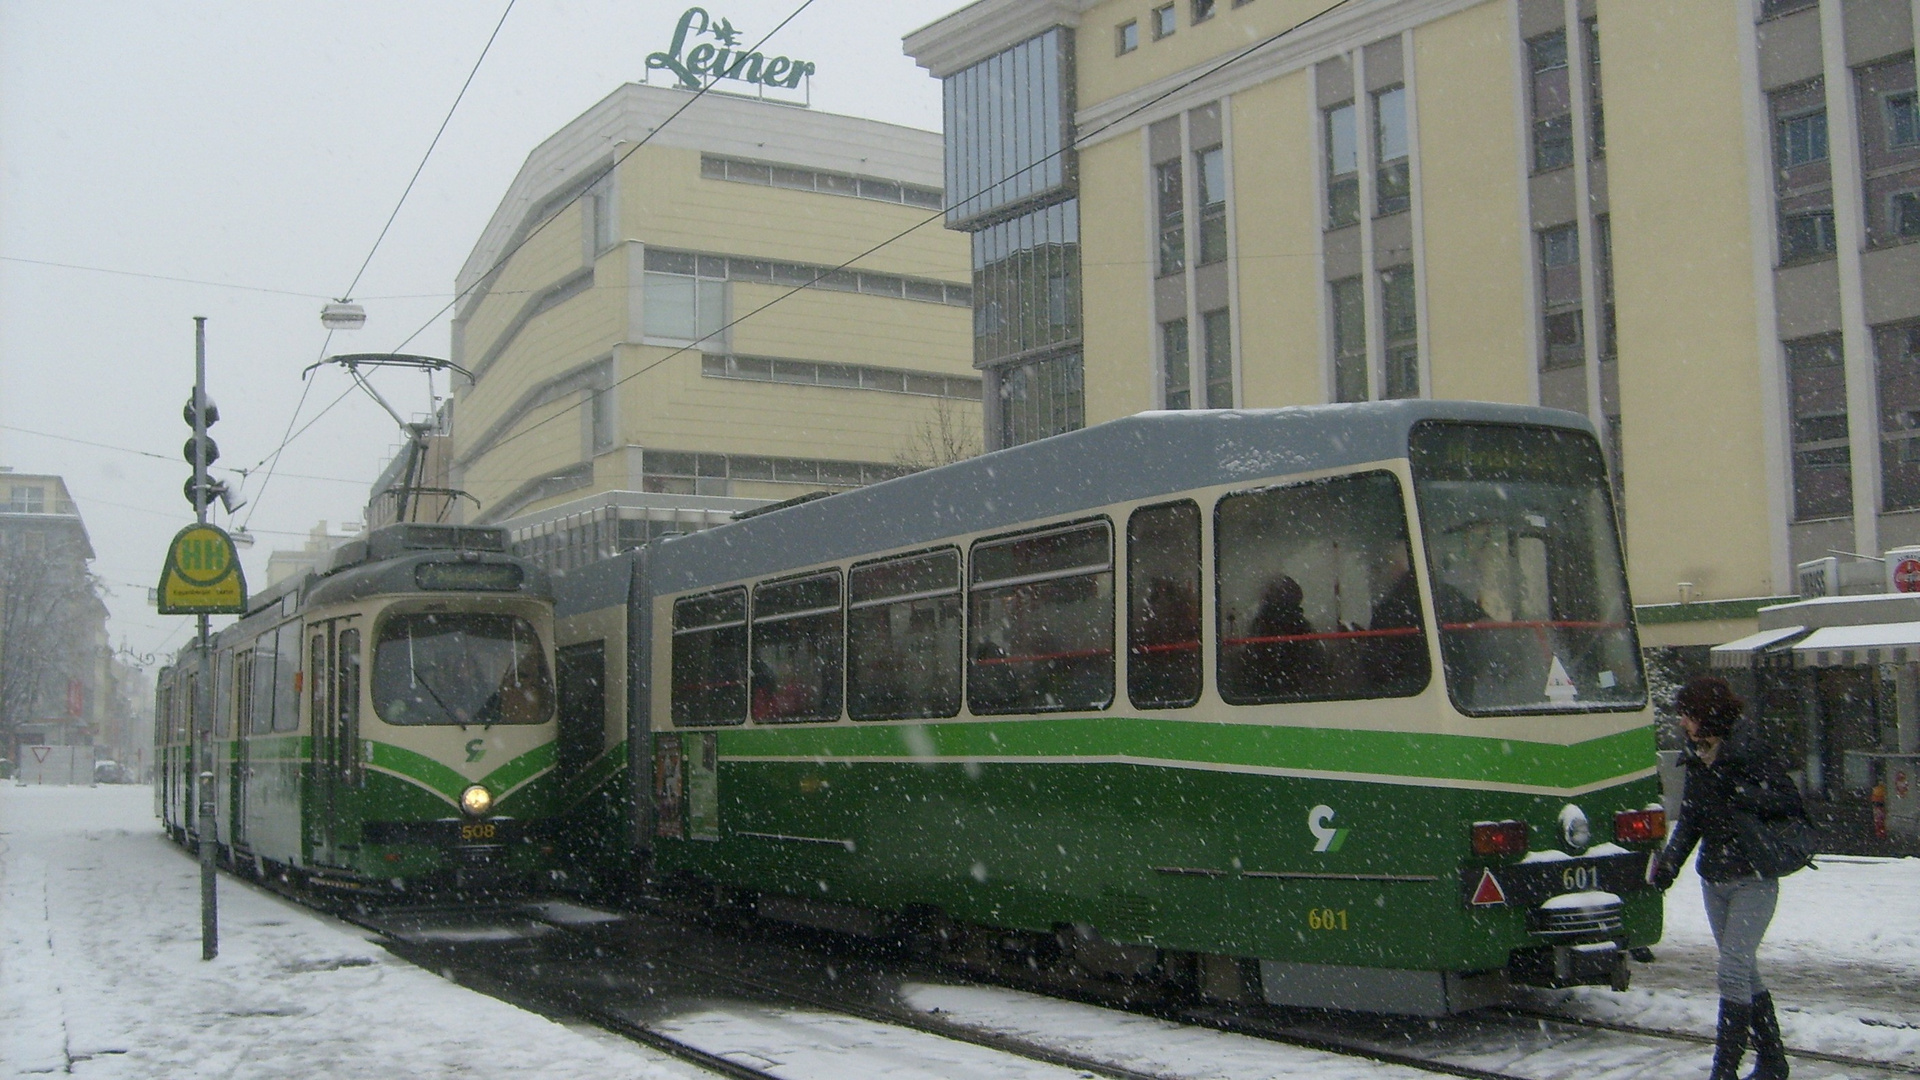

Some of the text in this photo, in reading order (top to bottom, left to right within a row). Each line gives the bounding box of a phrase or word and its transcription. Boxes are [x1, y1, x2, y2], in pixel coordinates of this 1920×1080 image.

[645, 6, 816, 89] Leiner
[462, 824, 495, 840] 508
[1563, 866, 1599, 890] 601
[1308, 908, 1348, 931] 601
